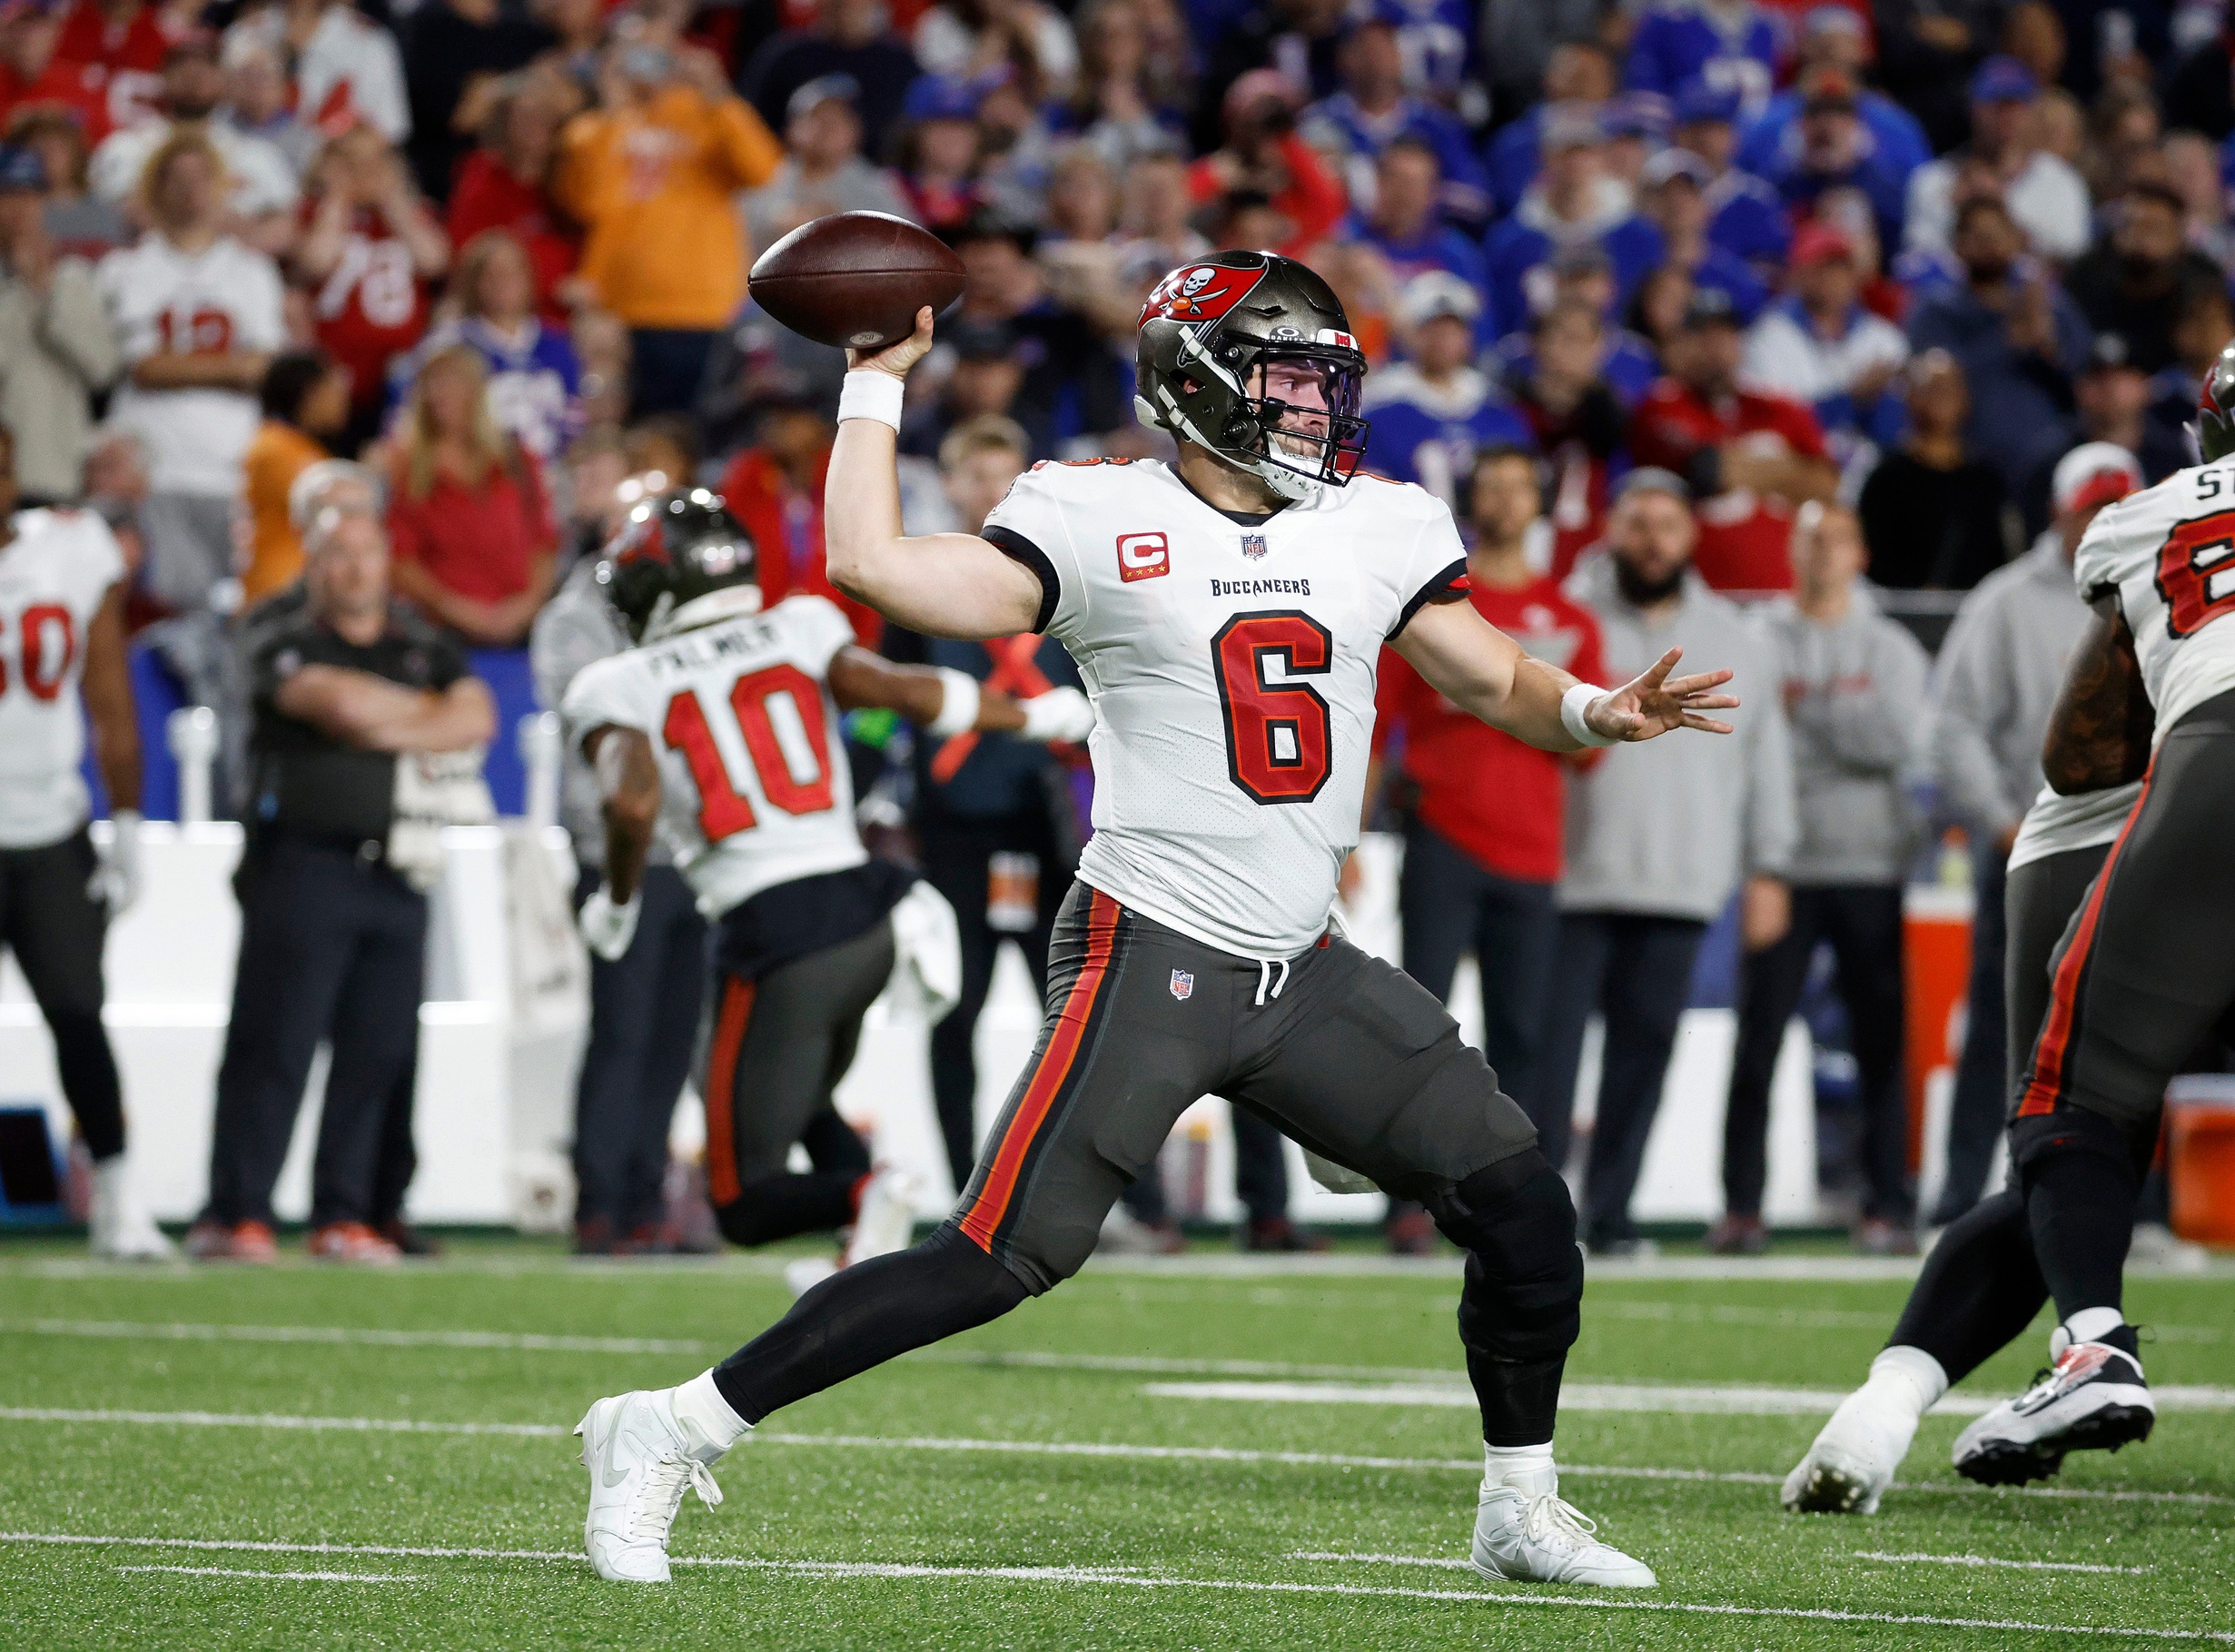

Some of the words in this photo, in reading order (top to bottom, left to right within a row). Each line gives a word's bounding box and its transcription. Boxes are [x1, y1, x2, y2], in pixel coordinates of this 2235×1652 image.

[1122, 535, 1166, 569] C
[663, 662, 834, 846] 10
[1210, 609, 1332, 806] 6
